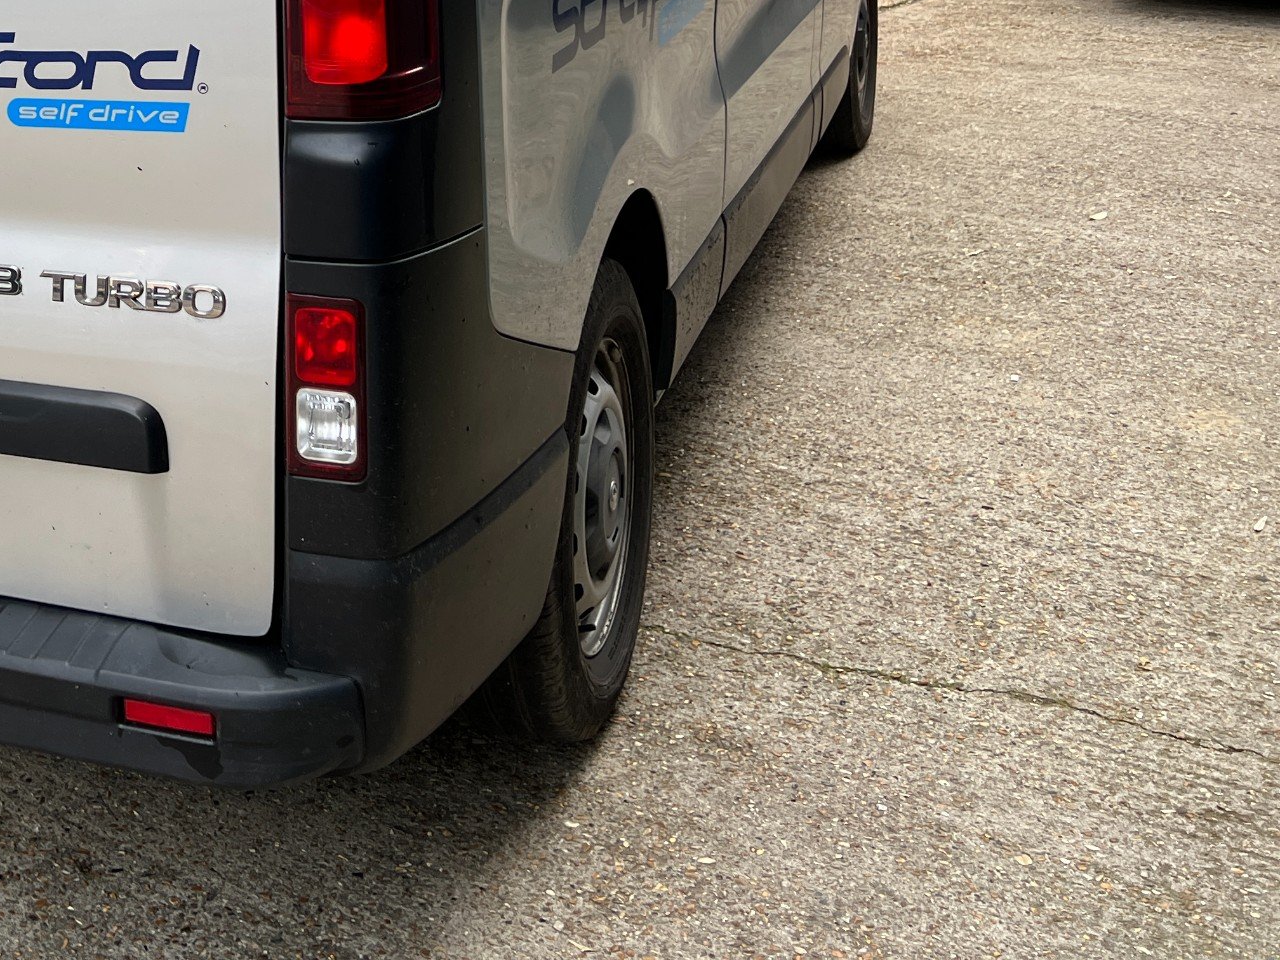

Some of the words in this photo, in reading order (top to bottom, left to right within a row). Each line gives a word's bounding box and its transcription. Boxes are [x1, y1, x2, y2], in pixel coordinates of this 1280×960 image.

[18, 103, 84, 126] self
[88, 103, 180, 125] drive
[39, 268, 227, 320] TURBO
